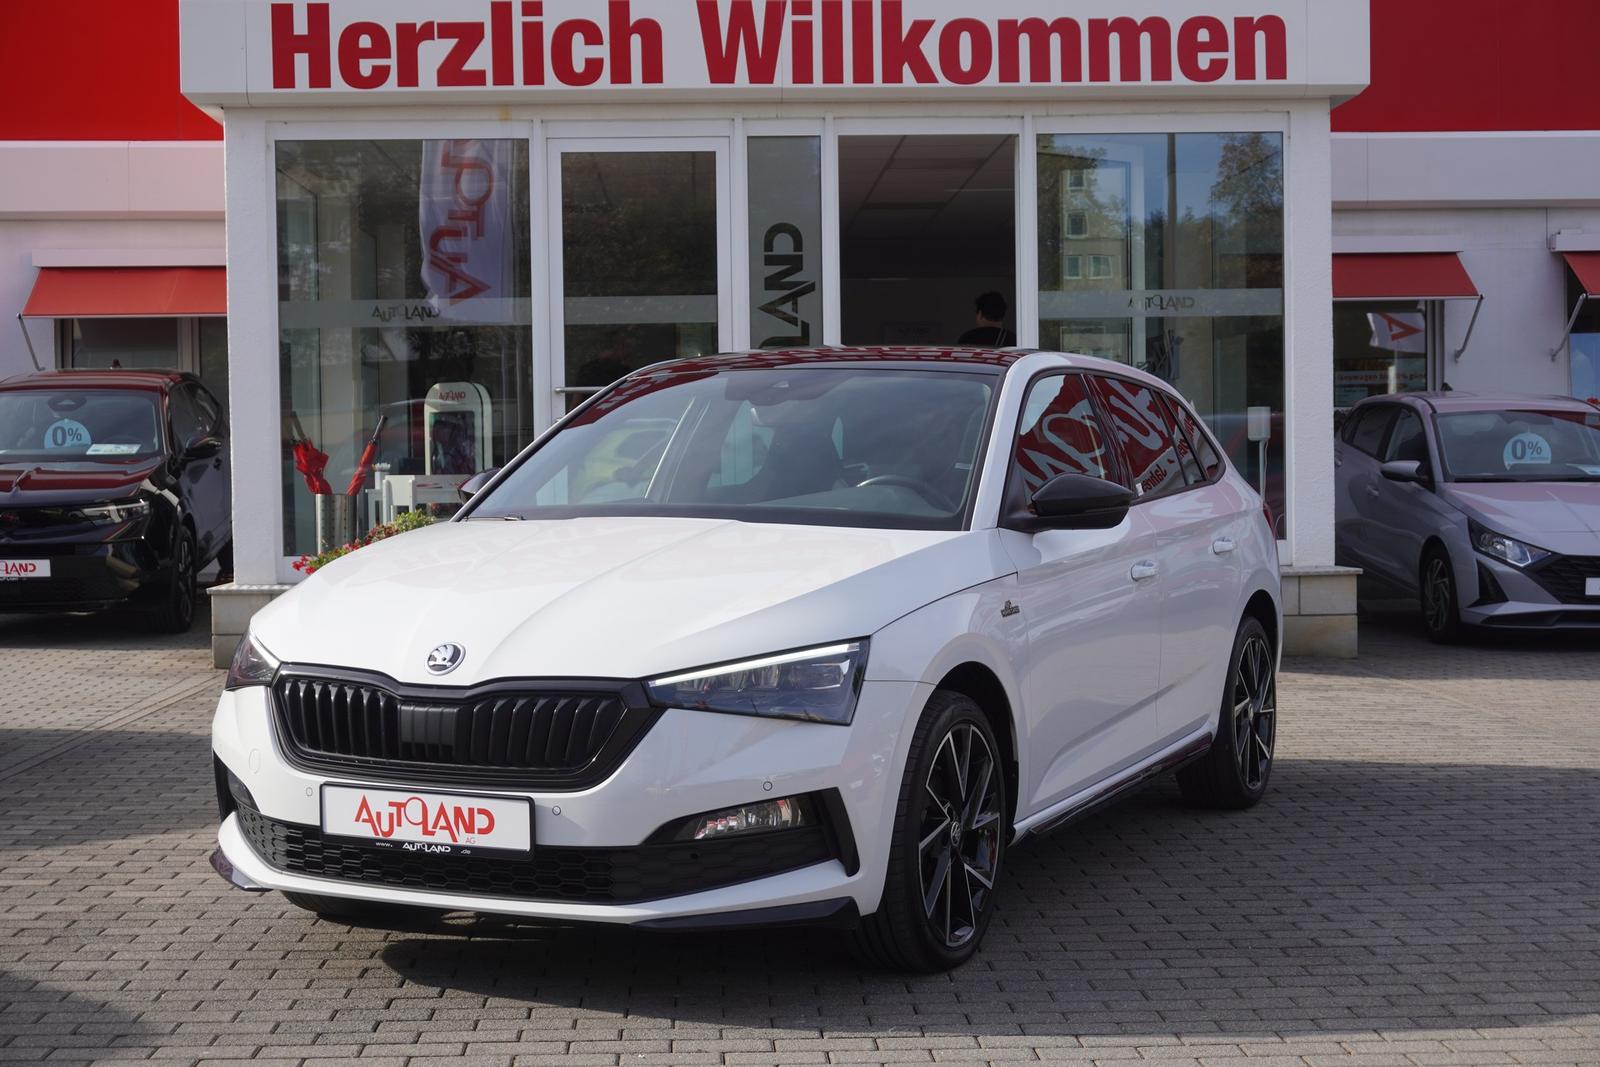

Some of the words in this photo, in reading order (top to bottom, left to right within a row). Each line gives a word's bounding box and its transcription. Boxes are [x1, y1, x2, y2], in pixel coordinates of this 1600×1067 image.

[271, 0, 663, 89] Herzlich
[695, 0, 1287, 85] Willkommen
[52, 426, 82, 447] 0%
[1511, 439, 1542, 460] 0%
[354, 794, 495, 843] AUTOLAND
[402, 842, 451, 854] AUTOLAND
